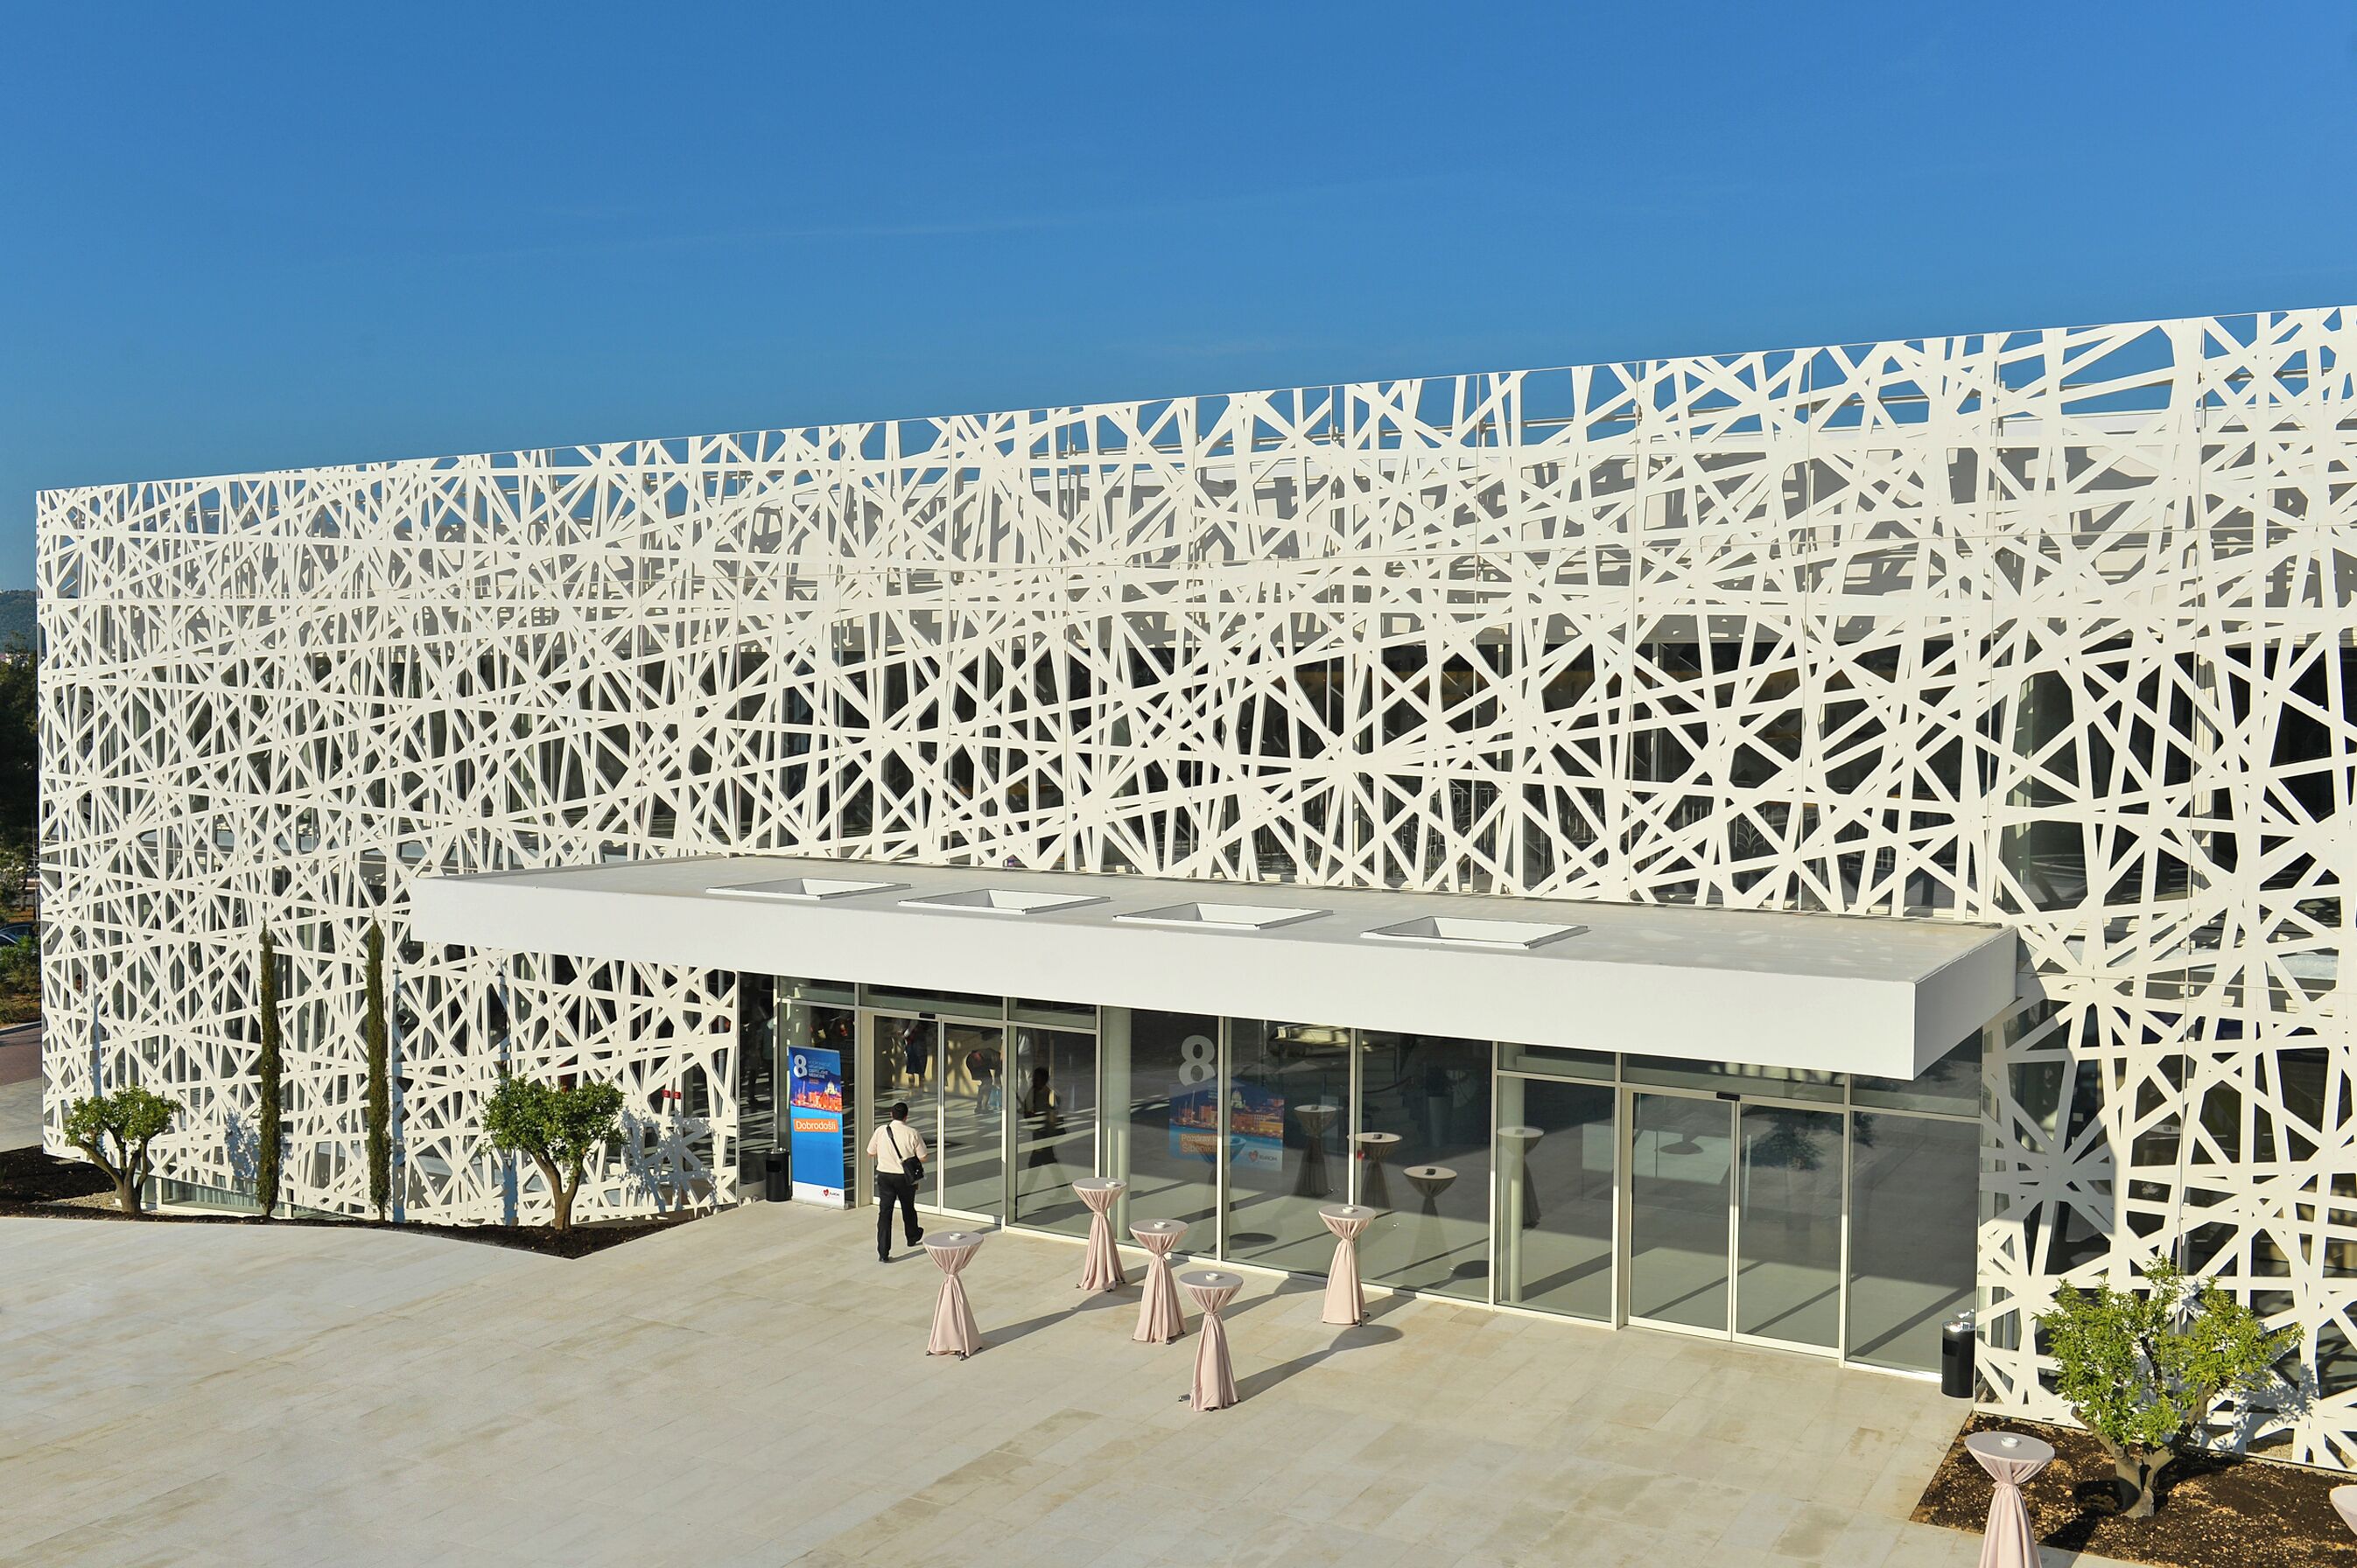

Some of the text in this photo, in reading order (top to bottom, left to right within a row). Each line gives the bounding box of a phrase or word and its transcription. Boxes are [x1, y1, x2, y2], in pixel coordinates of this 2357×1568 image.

[793, 1054, 807, 1078] 8
[1179, 1035, 1216, 1086] 8
[796, 1120, 836, 1130] Dobrodošli
